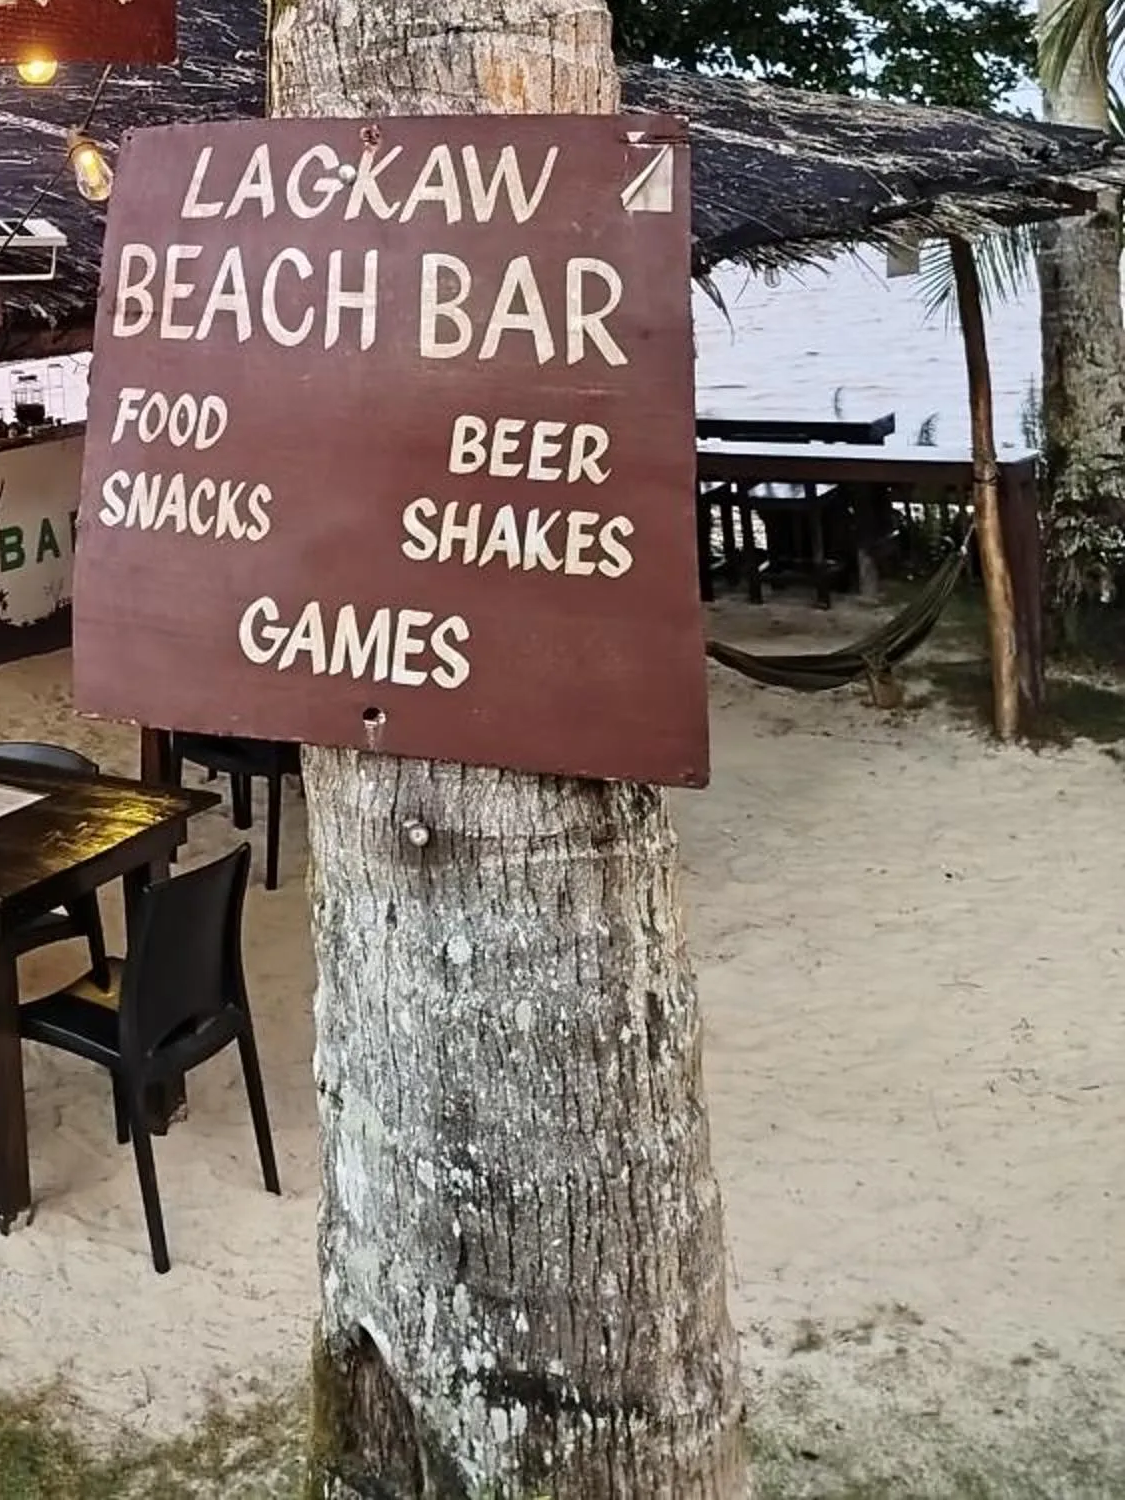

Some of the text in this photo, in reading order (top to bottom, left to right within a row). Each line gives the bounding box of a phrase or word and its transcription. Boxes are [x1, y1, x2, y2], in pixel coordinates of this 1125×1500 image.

[181, 144, 558, 224] LAGKAW
[112, 243, 628, 366] BEACH BAR
[111, 387, 228, 449] FOOD
[449, 415, 611, 484] BEER
[99, 469, 273, 541] SNACKS
[401, 498, 635, 578] SHAKES
[239, 596, 470, 688] GAMES
